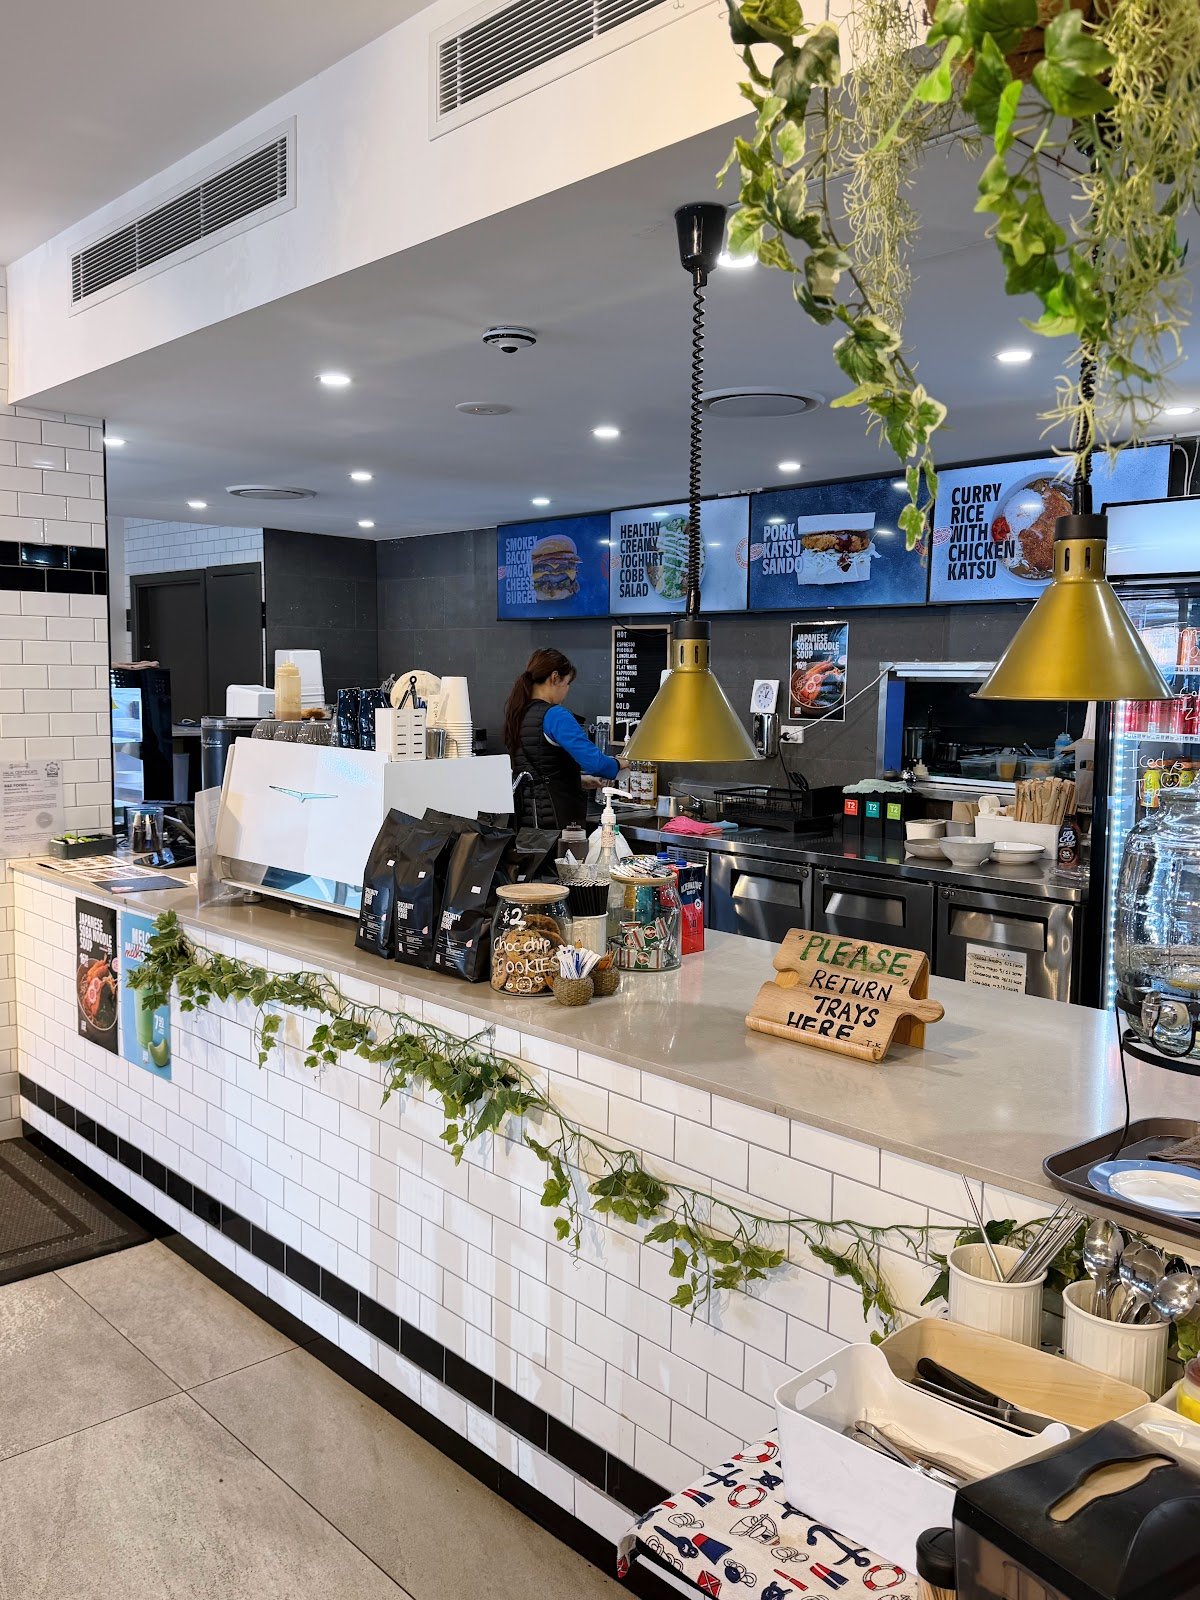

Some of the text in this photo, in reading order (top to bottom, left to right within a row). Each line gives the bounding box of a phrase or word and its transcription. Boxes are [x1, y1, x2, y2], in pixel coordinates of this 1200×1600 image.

[952, 483, 1002, 506] CURRY
[951, 504, 984, 524] RICE
[620, 522, 661, 539] HEALTHY
[764, 523, 795, 542] PORK
[950, 523, 988, 543] WITH
[506, 536, 538, 551] SMOKEY
[620, 537, 658, 554] CREAMY
[763, 540, 801, 558] KATSU
[948, 541, 1015, 562] CHICKEN
[506, 551, 532, 564] BACON
[620, 552, 664, 568] YOGHURT
[762, 556, 803, 575] SANDO
[620, 568, 644, 583] COBB
[948, 561, 996, 580] KATSU
[506, 578, 534, 591] CHEESE
[620, 583, 648, 598] SALAD
[506, 591, 538, 604] BURGER
[796, 642, 839, 650] SOBA NOODLE
[798, 634, 828, 642] JAPANESE
[796, 651, 813, 659] SOUP
[616, 702, 630, 710] COLD
[1125, 749, 1165, 769] Iced
[79, 912, 103, 932] JAPANESE
[502, 908, 526, 925] $2
[80, 936, 92, 952] SOUP
[93, 929, 112, 948] NOODLE
[132, 928, 154, 946] MELO
[494, 936, 550, 953] Choc chip
[498, 957, 560, 974] COOKIES
[809, 969, 893, 1001] RETURN
[814, 996, 879, 1027] TRAYS
[787, 1012, 854, 1039] HERE
